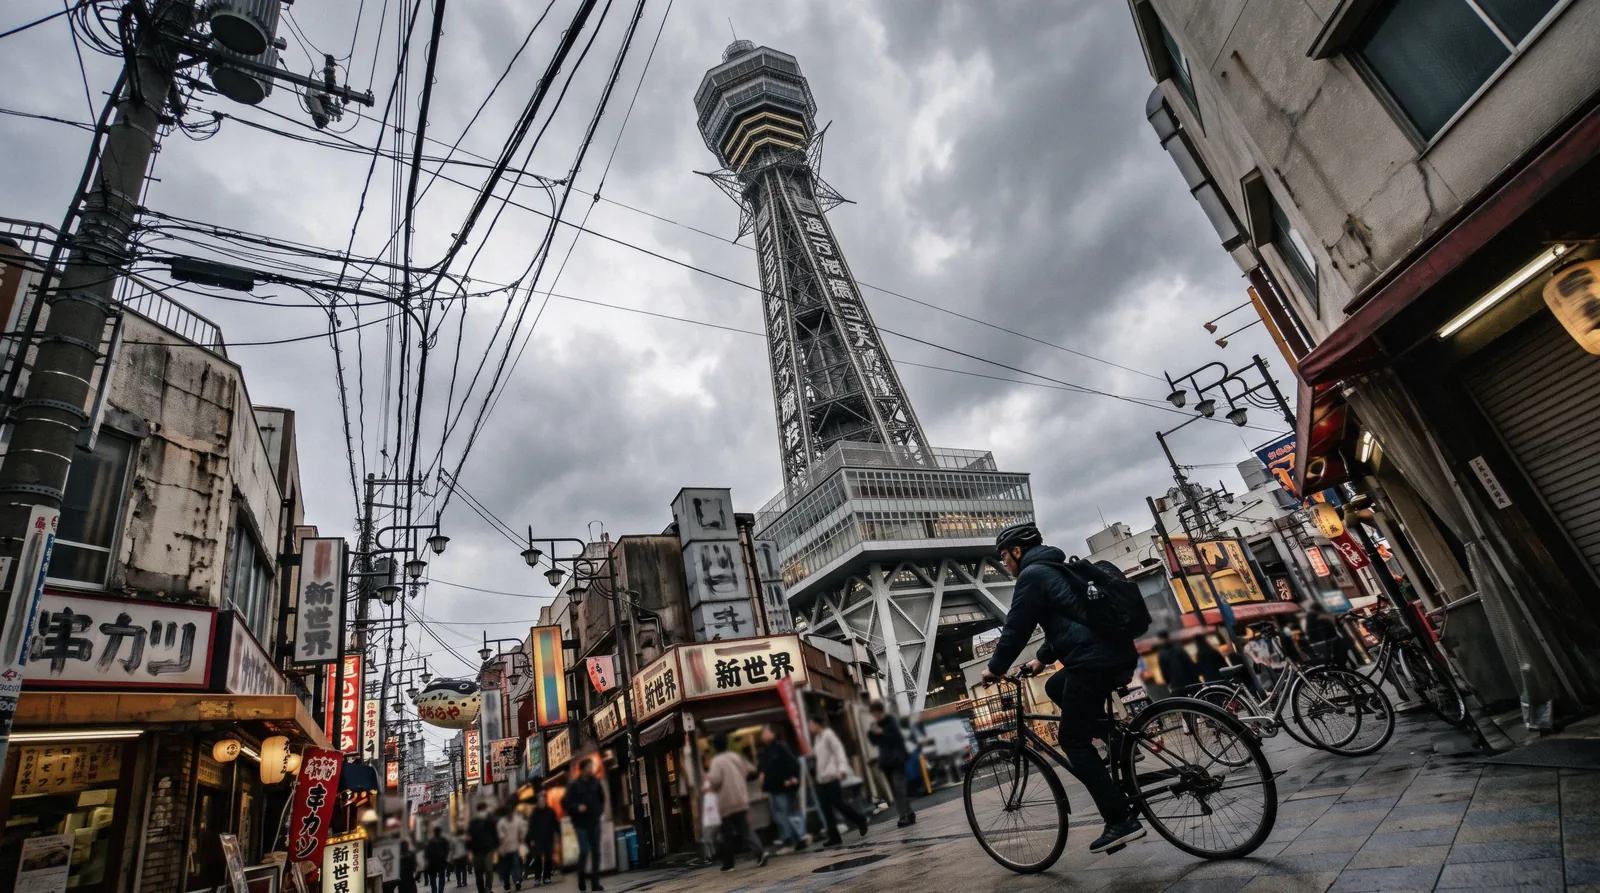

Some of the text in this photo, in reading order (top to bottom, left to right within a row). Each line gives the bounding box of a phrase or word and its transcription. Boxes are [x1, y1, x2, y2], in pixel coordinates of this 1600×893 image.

[301, 580, 335, 657] 新世界
[643, 667, 678, 713] 新世界
[714, 650, 795, 690] 新世界
